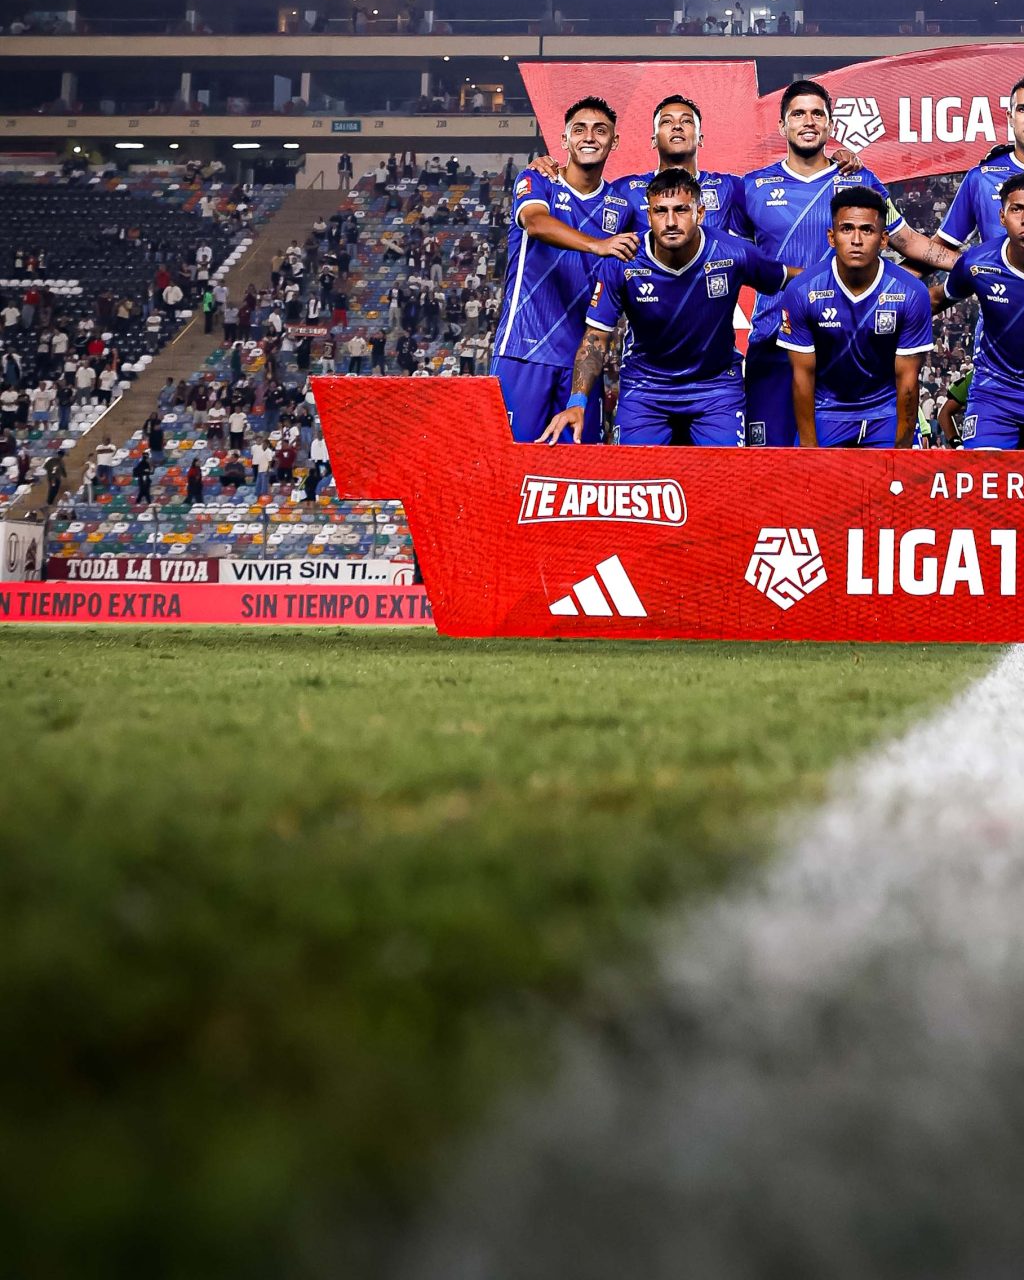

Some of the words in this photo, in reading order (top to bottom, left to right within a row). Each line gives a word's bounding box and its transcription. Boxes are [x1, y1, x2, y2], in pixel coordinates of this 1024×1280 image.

[986, 294, 1009, 304] walon
[524, 481, 558, 518] TE
[559, 484, 682, 522] APUESTO
[66, 559, 119, 580] TODA
[125, 559, 152, 581] LA
[160, 560, 209, 582] VIDA
[231, 563, 292, 581] VIVIR
[299, 561, 340, 580] SIN
[846, 528, 1017, 596] LIGA1
[17, 592, 103, 617] TIEMPO
[108, 592, 182, 618] EXTRA
[241, 593, 278, 619] SIN
[284, 593, 370, 619] TIEMPO
[375, 594, 433, 620] EXTR
